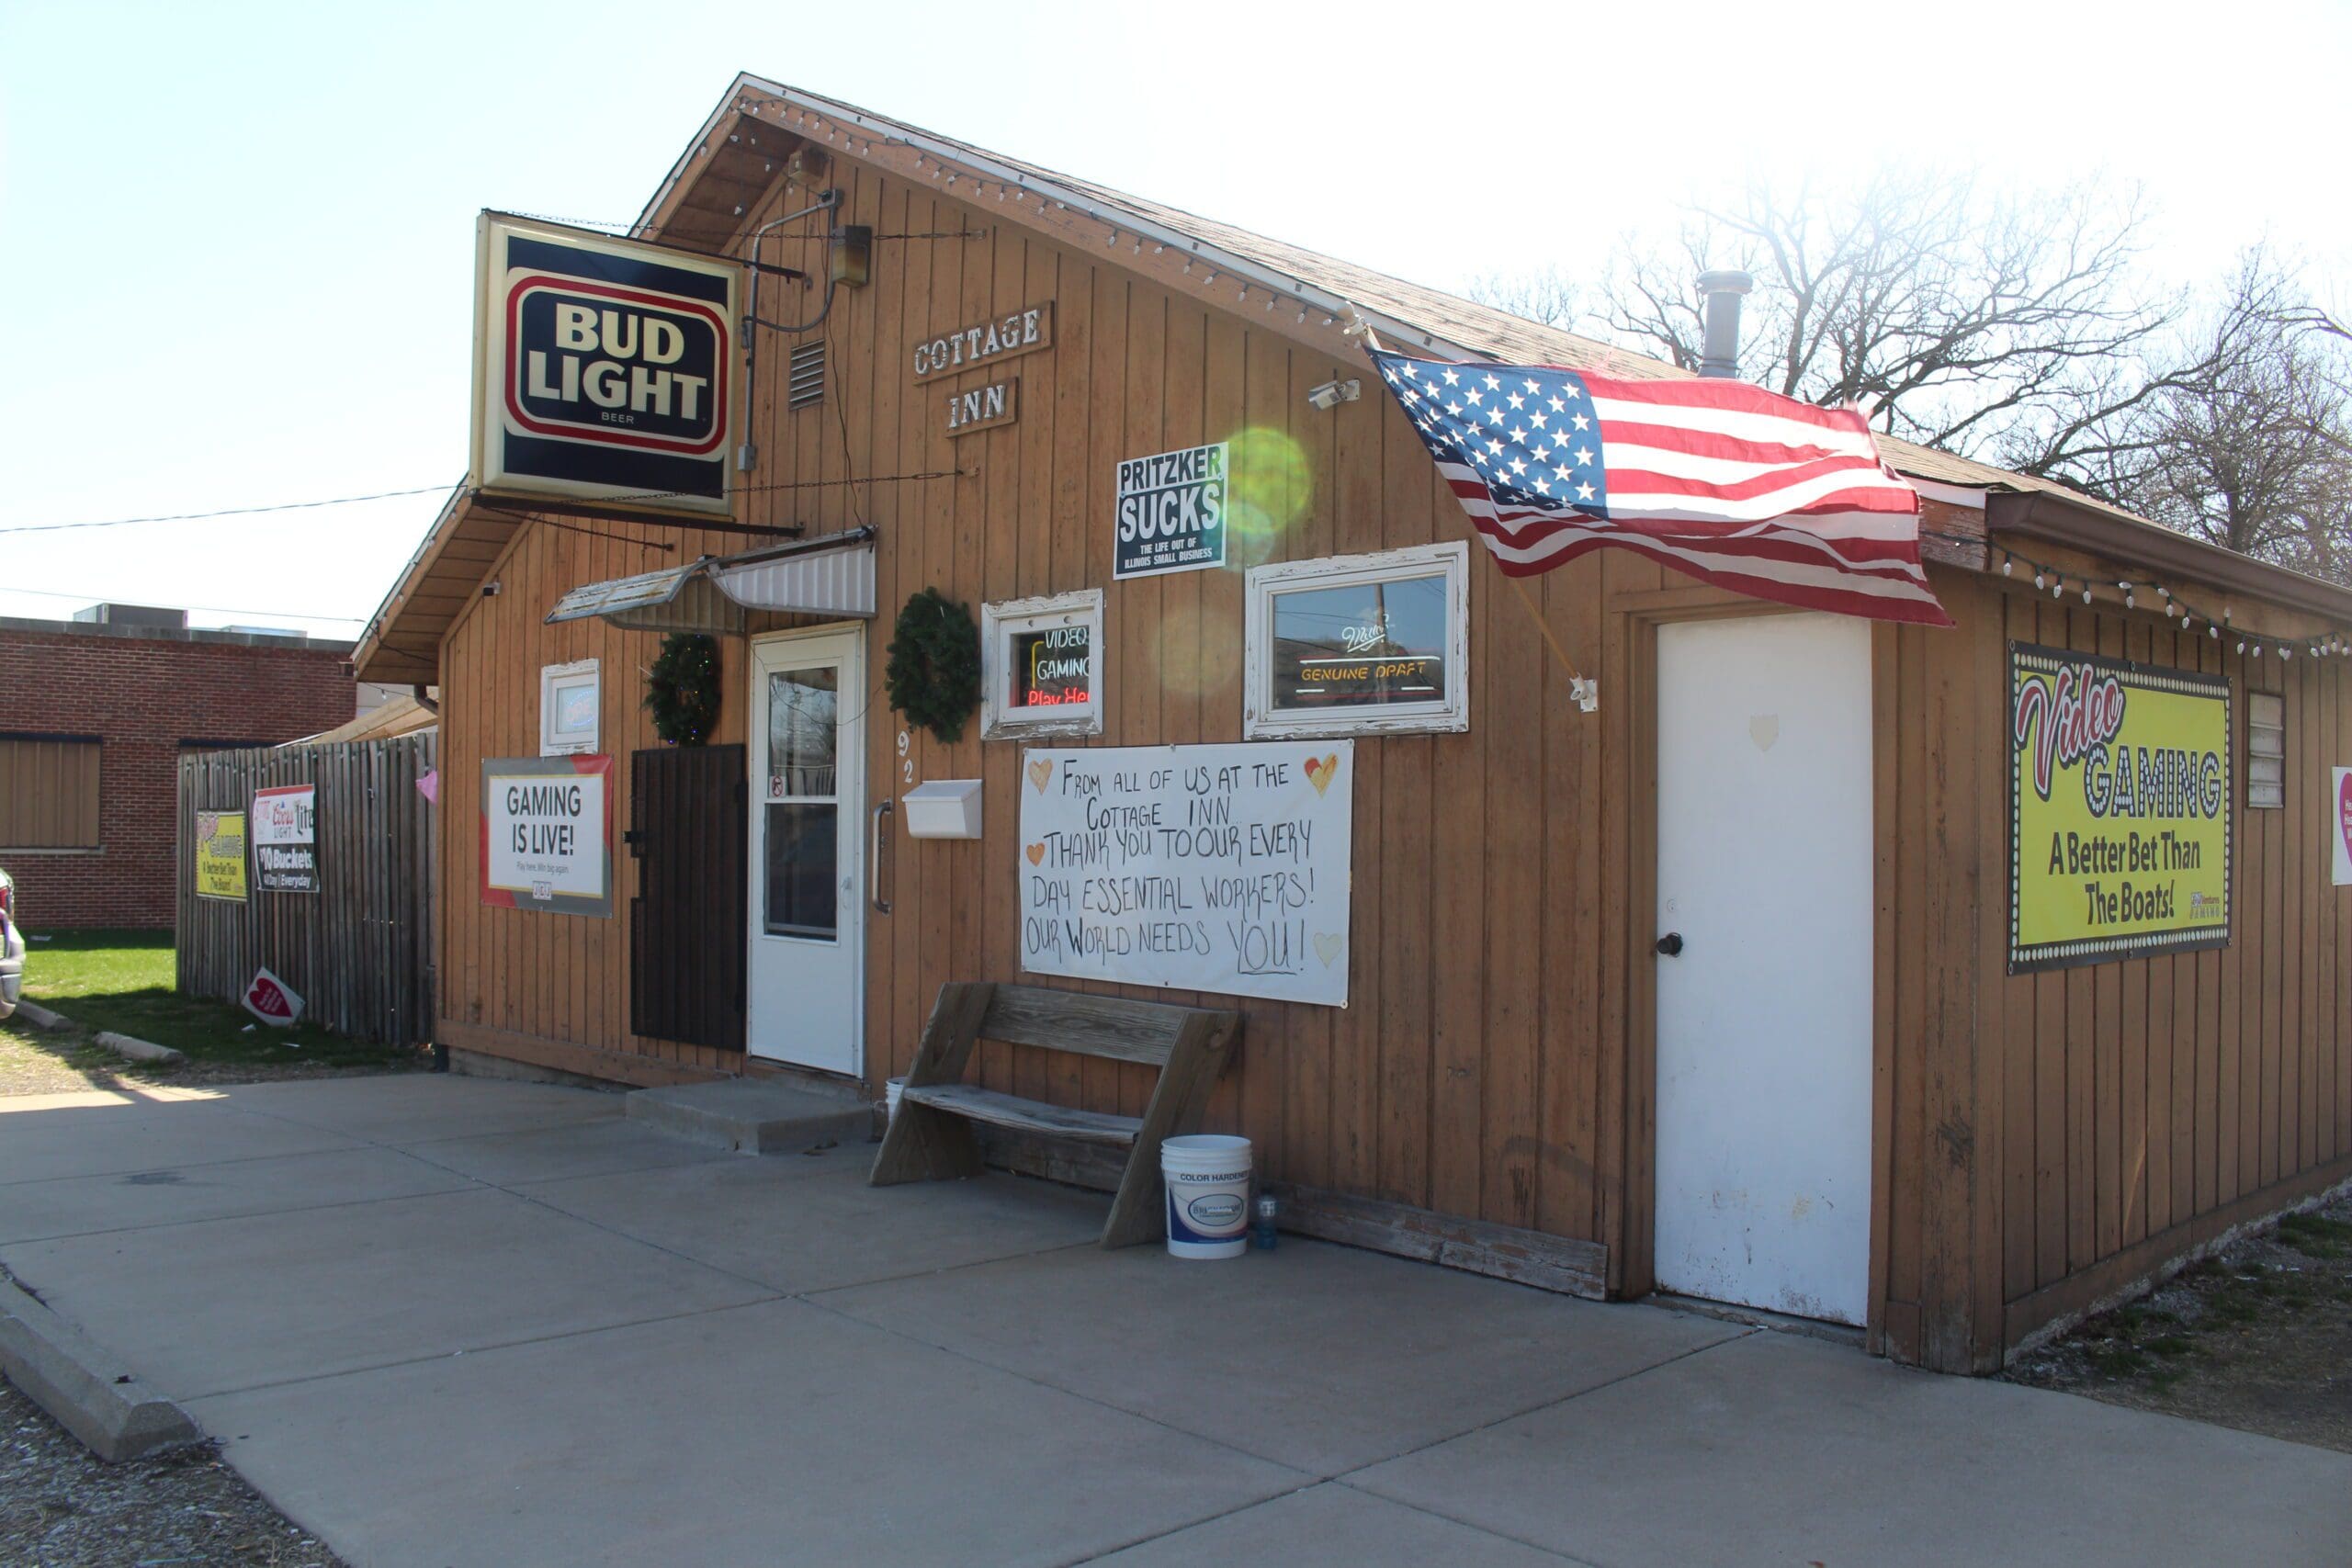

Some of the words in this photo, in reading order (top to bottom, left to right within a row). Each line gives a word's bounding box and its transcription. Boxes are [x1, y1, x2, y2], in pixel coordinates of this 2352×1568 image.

[556, 302, 684, 365] BUD
[915, 309, 1039, 375] COTTAGE
[528, 350, 707, 420] LIGHT
[602, 412, 634, 424] BEER
[949, 384, 1006, 428] INN
[1121, 446, 1222, 492] PRITZKER
[1119, 483, 1220, 543] SUCKS
[1125, 557, 1150, 569] ILLINOIS
[1154, 554, 1176, 565] SMALL
[1179, 547, 1213, 560] BUSINESS
[1140, 543, 1152, 555] THE
[1155, 541, 1169, 552] LIFE
[1171, 539, 1184, 549] OUT
[1187, 537, 1196, 548] OF
[1046, 627, 1086, 649] VIDEO
[1301, 667, 1369, 682] GENUINE
[1028, 690, 1061, 705] Play
[2015, 662, 2124, 801] Video
[1062, 759, 1102, 798] FROM
[1114, 772, 1141, 792] ALL
[1149, 770, 1173, 790] OF
[1184, 766, 1211, 795] US
[1218, 765, 1241, 794] AT
[1252, 763, 1288, 788] THE
[2084, 741, 2222, 819] GAMING
[507, 785, 581, 817] GAMING
[1087, 796, 1161, 830] COTTAGE
[1189, 796, 1230, 827] INN
[274, 827, 291, 839] LIGHT
[513, 824, 526, 853] IS
[532, 824, 573, 855] LIVE!
[1044, 829, 1110, 871] THANK
[1115, 829, 1152, 865] YOU
[1158, 829, 1192, 859] TO
[1195, 826, 1242, 866] OUR
[1250, 819, 1312, 864] EVERY
[2049, 832, 2064, 874] A
[2067, 831, 2125, 874] Better
[2129, 831, 2157, 872] Bet
[2161, 830, 2200, 870] Than
[274, 848, 312, 869] Buckets
[281, 874, 311, 888] Everyday
[1032, 875, 1070, 915] DAY
[1082, 876, 1193, 916] ESSENTIAL
[1201, 867, 1314, 921] WORKERS!
[2085, 881, 2118, 925] The
[2121, 879, 2175, 923] Boats!
[1026, 916, 1061, 964] OUR
[1066, 917, 1131, 965] WORLD
[1138, 920, 1210, 955] NEEDS
[1227, 919, 1305, 975] YOU!
[1180, 1172, 1209, 1181] COLOR
